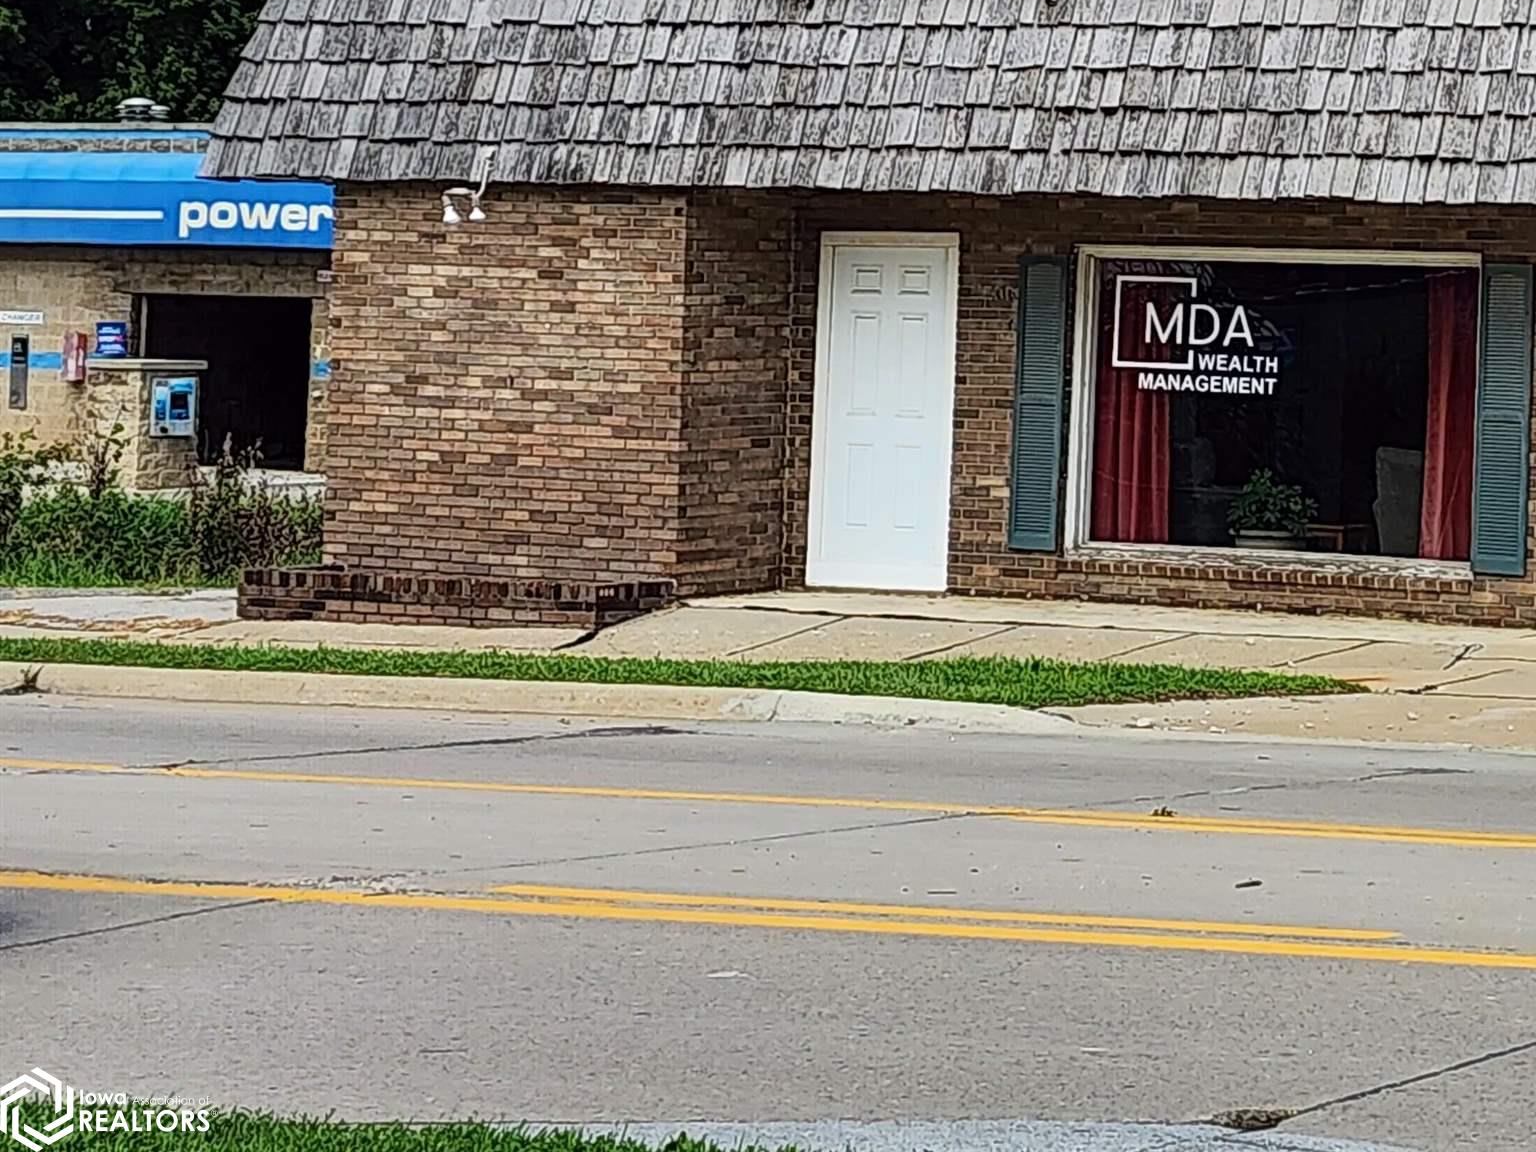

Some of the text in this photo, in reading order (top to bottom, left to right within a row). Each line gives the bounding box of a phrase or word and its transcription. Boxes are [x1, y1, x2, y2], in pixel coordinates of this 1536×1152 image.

[179, 201, 334, 238] power
[1145, 302, 1254, 347] MDA
[1198, 354, 1279, 373] WEALTH
[1138, 372, 1278, 395] MANAGEMENT
